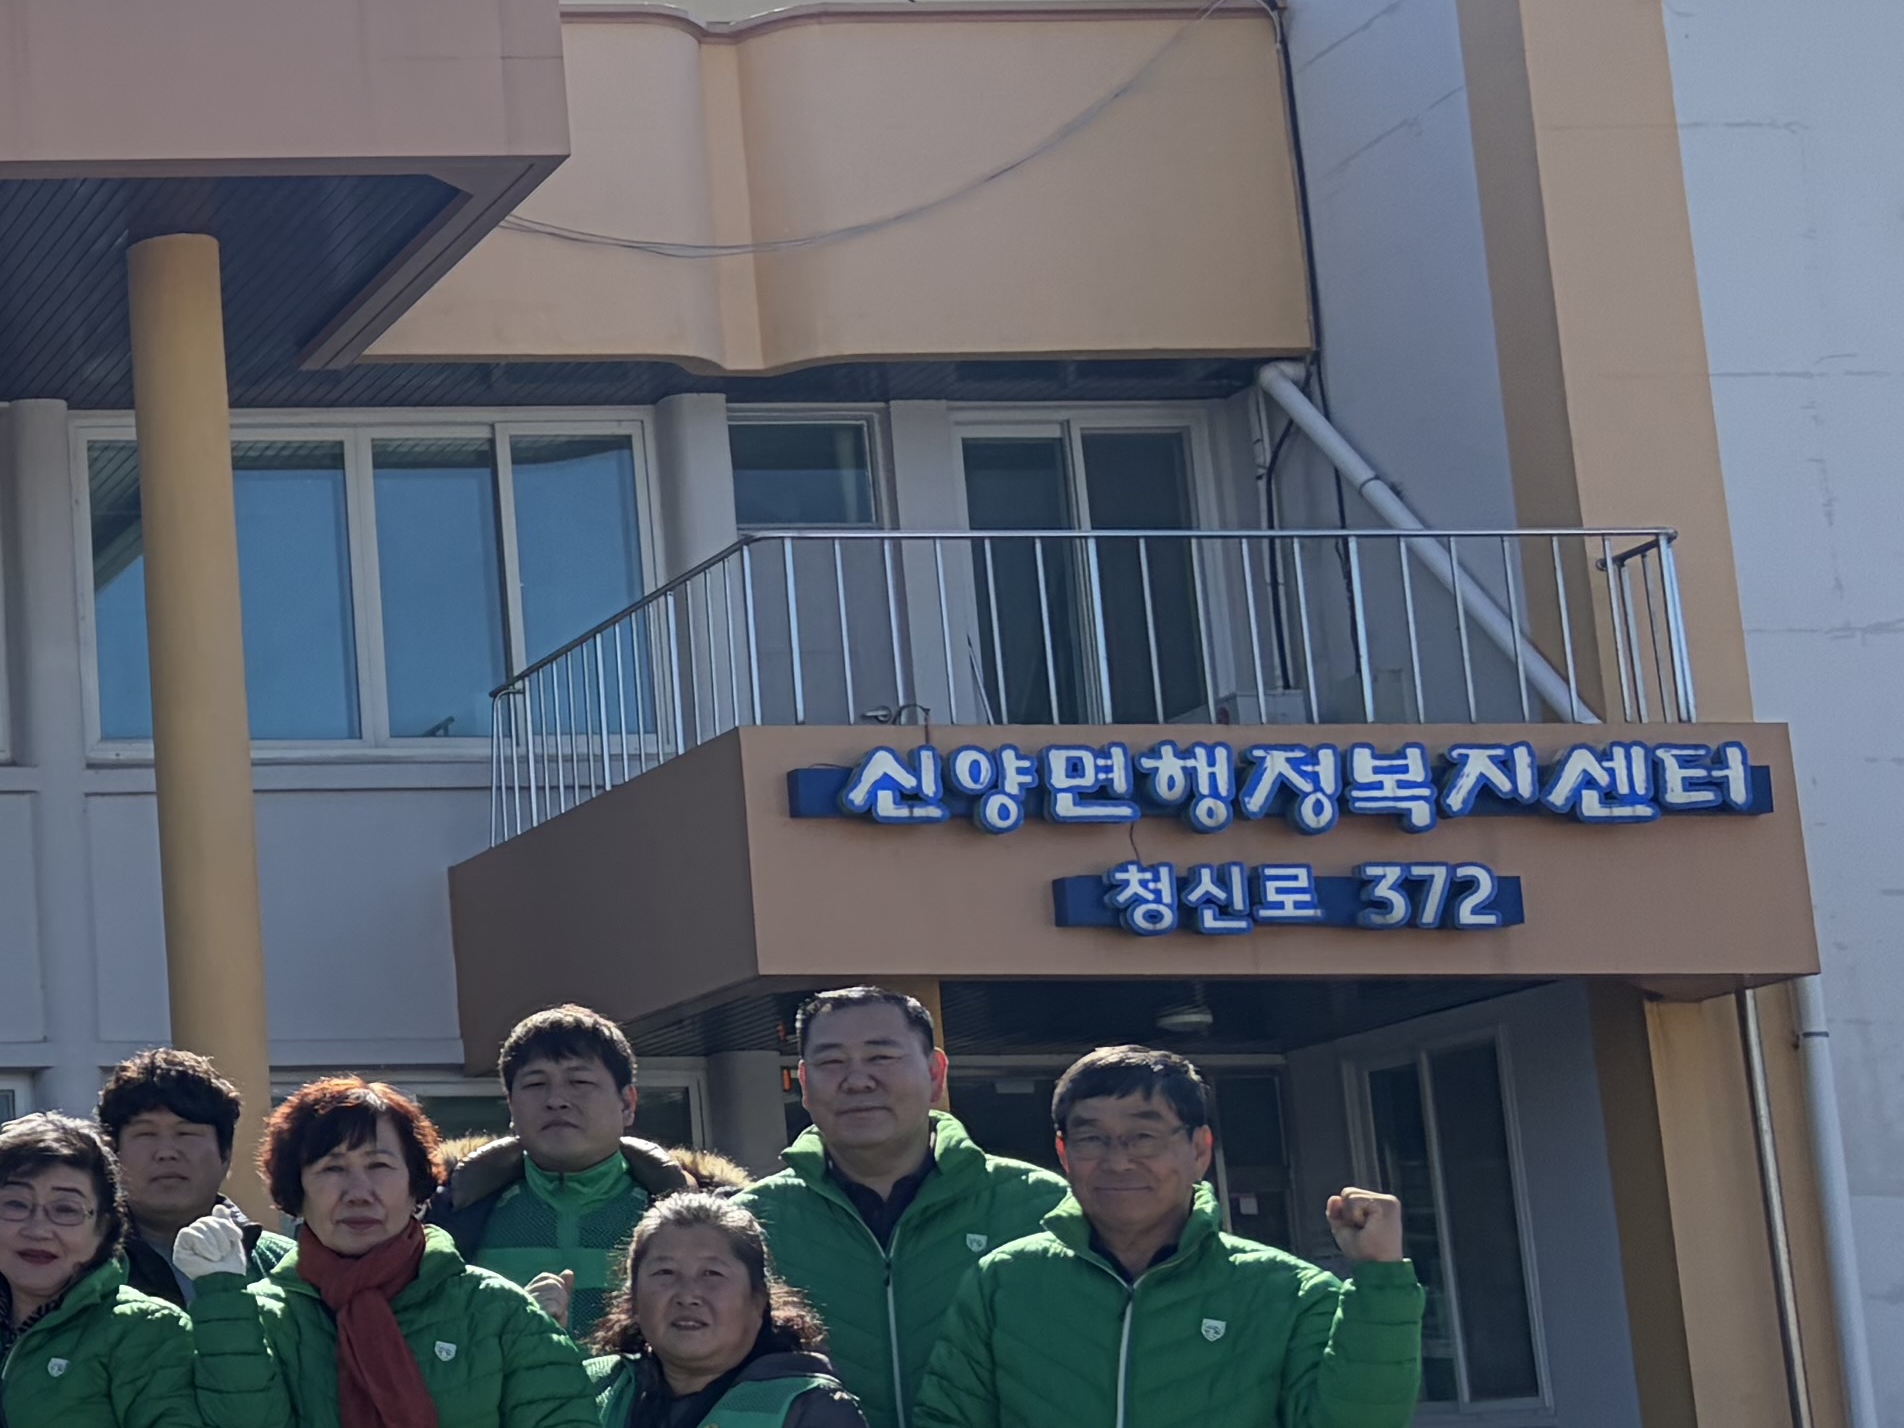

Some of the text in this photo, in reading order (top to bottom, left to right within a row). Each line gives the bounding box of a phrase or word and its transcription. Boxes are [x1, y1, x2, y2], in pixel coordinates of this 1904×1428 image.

[846, 743, 1749, 831] 신양면행정복지센터
[1112, 863, 1499, 932] 청신로 372
